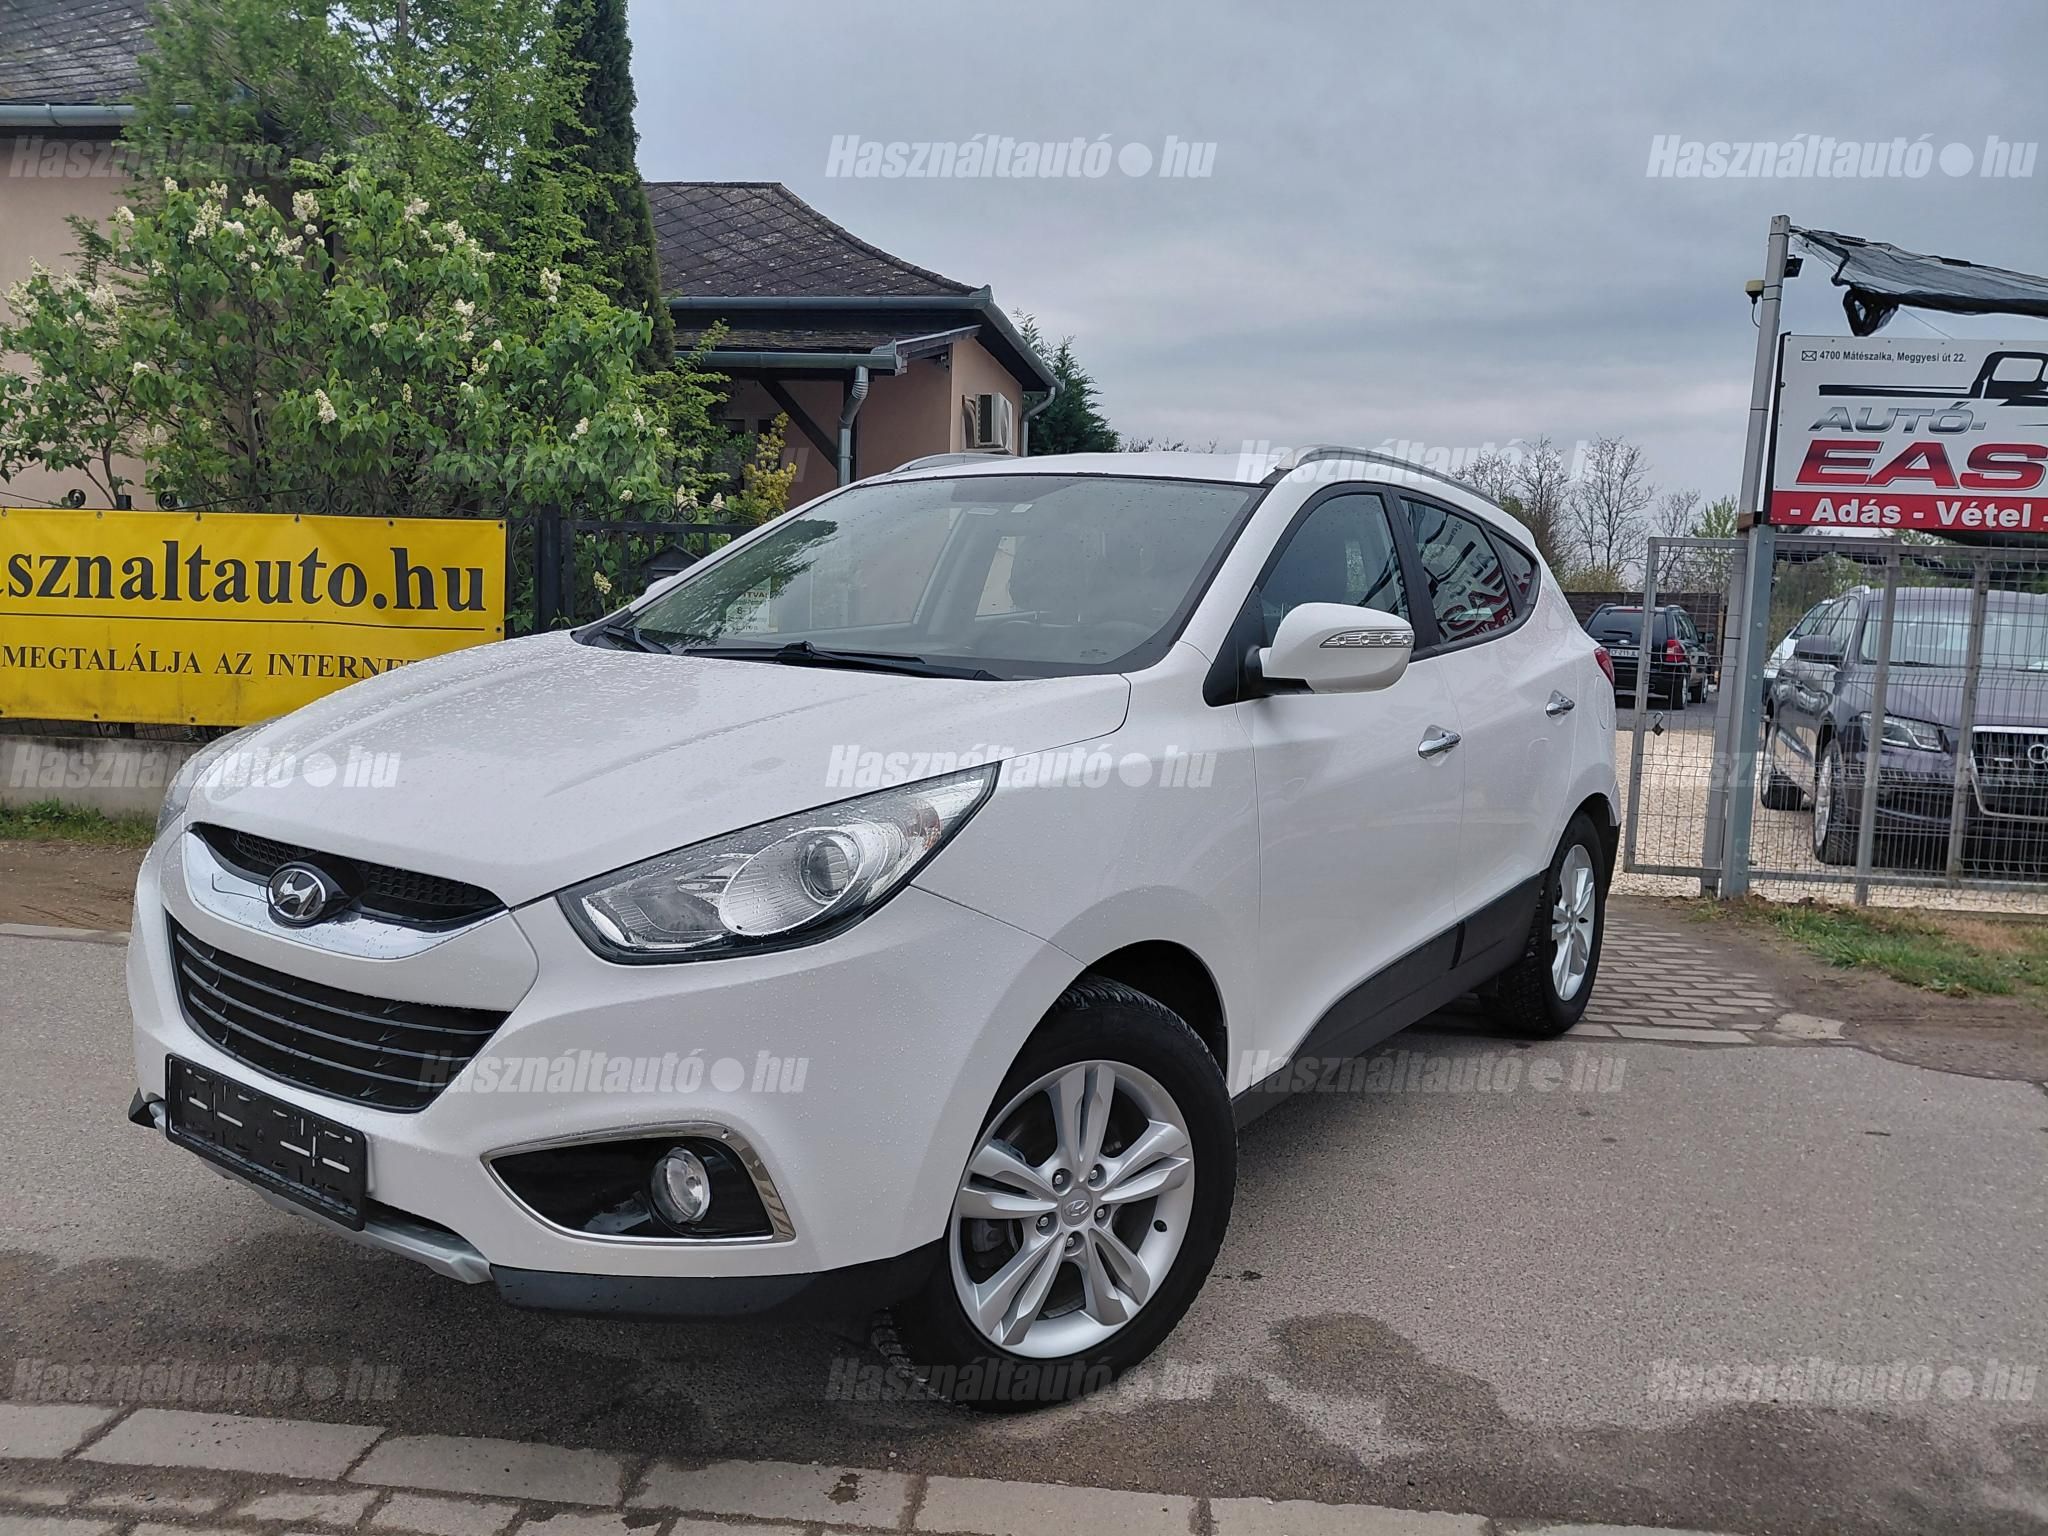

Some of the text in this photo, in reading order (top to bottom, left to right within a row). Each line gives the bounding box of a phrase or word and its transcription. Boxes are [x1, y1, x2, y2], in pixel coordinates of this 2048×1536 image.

[1820, 351, 1841, 360] 4700
[1811, 498, 1901, 524] Adás
[1936, 501, 2032, 527] Vétel
[0, 540, 487, 612] sznaltauto.hu
[2, 643, 203, 674] MEGTALÁLJA
[214, 652, 253, 675] AZ
